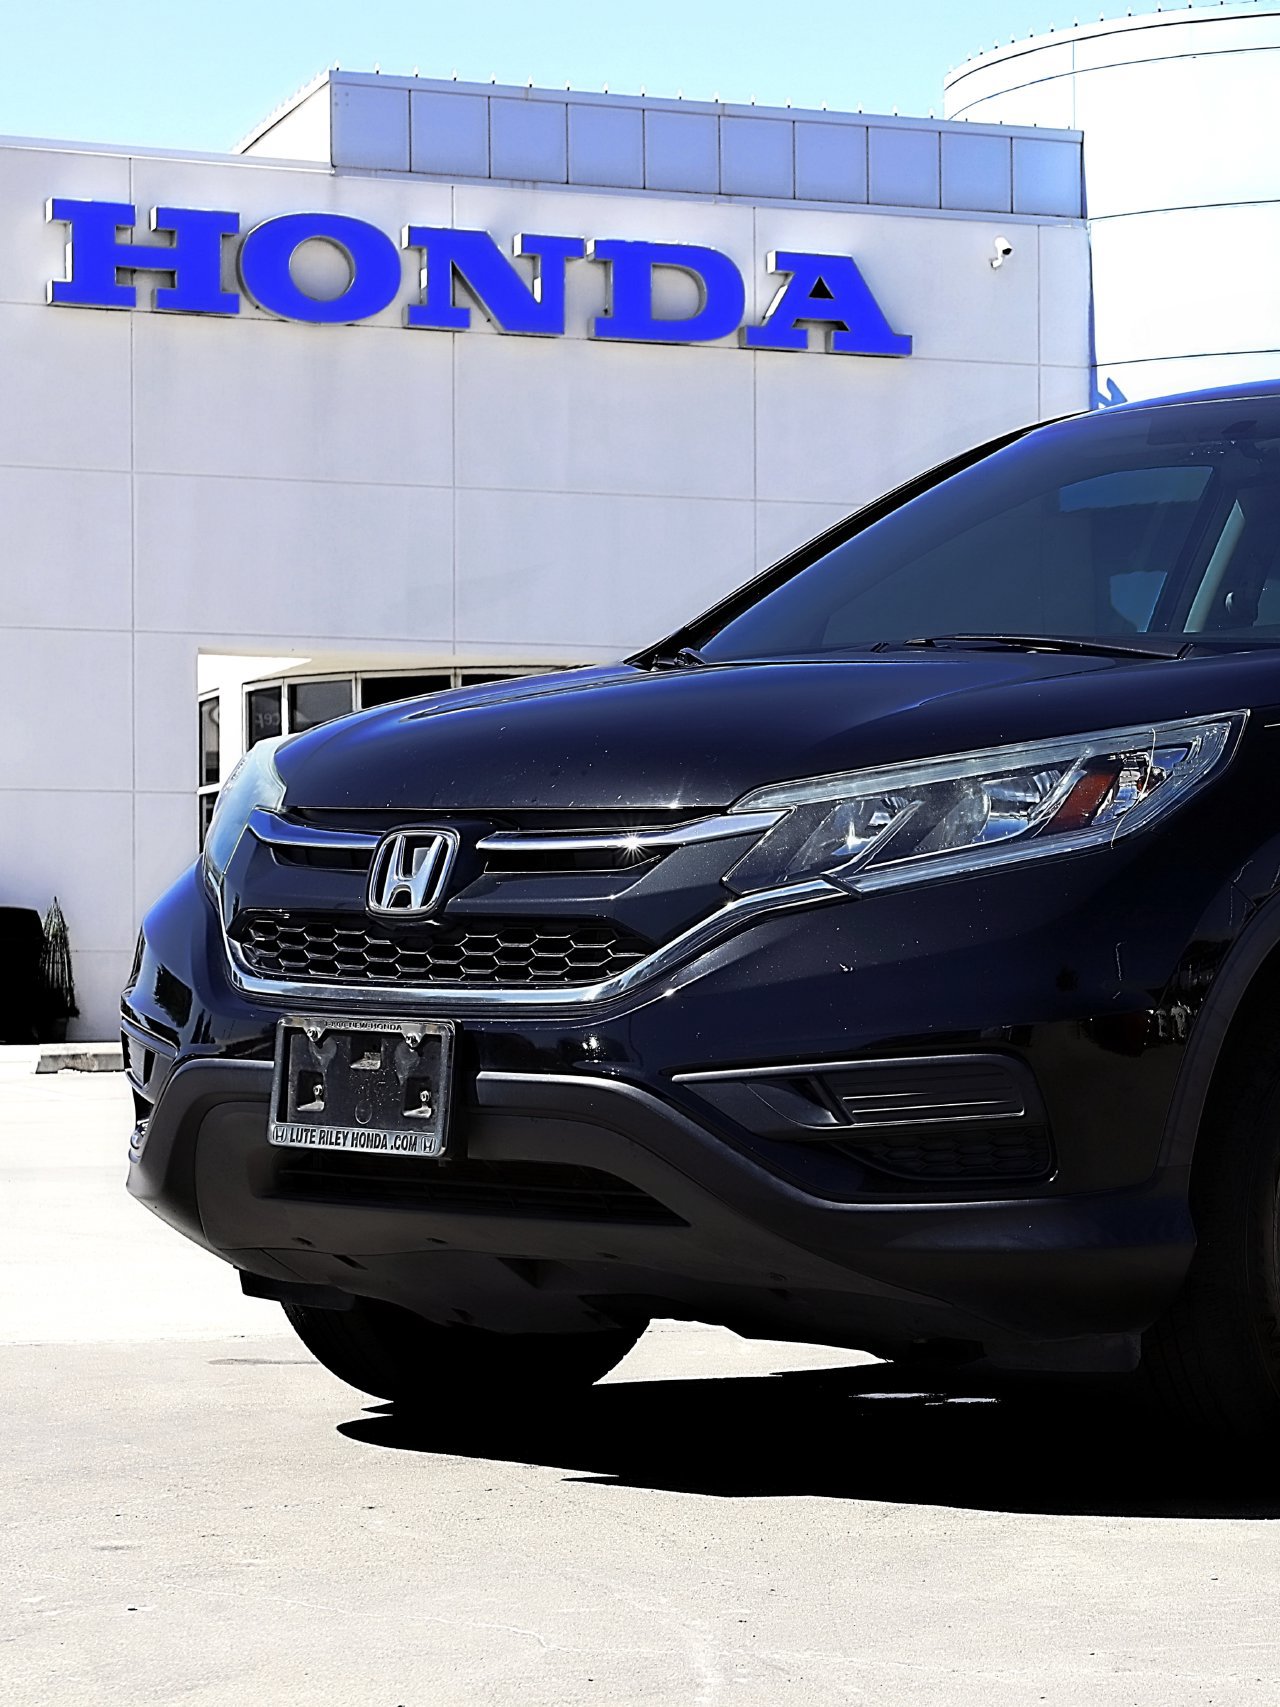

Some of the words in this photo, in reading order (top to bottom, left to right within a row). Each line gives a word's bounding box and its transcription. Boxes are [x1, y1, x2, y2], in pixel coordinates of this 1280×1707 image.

[46, 198, 913, 357] HONDA
[289, 1127, 316, 1144] LUTE
[318, 1129, 350, 1147] RILEY
[350, 1131, 388, 1150] HONDA
